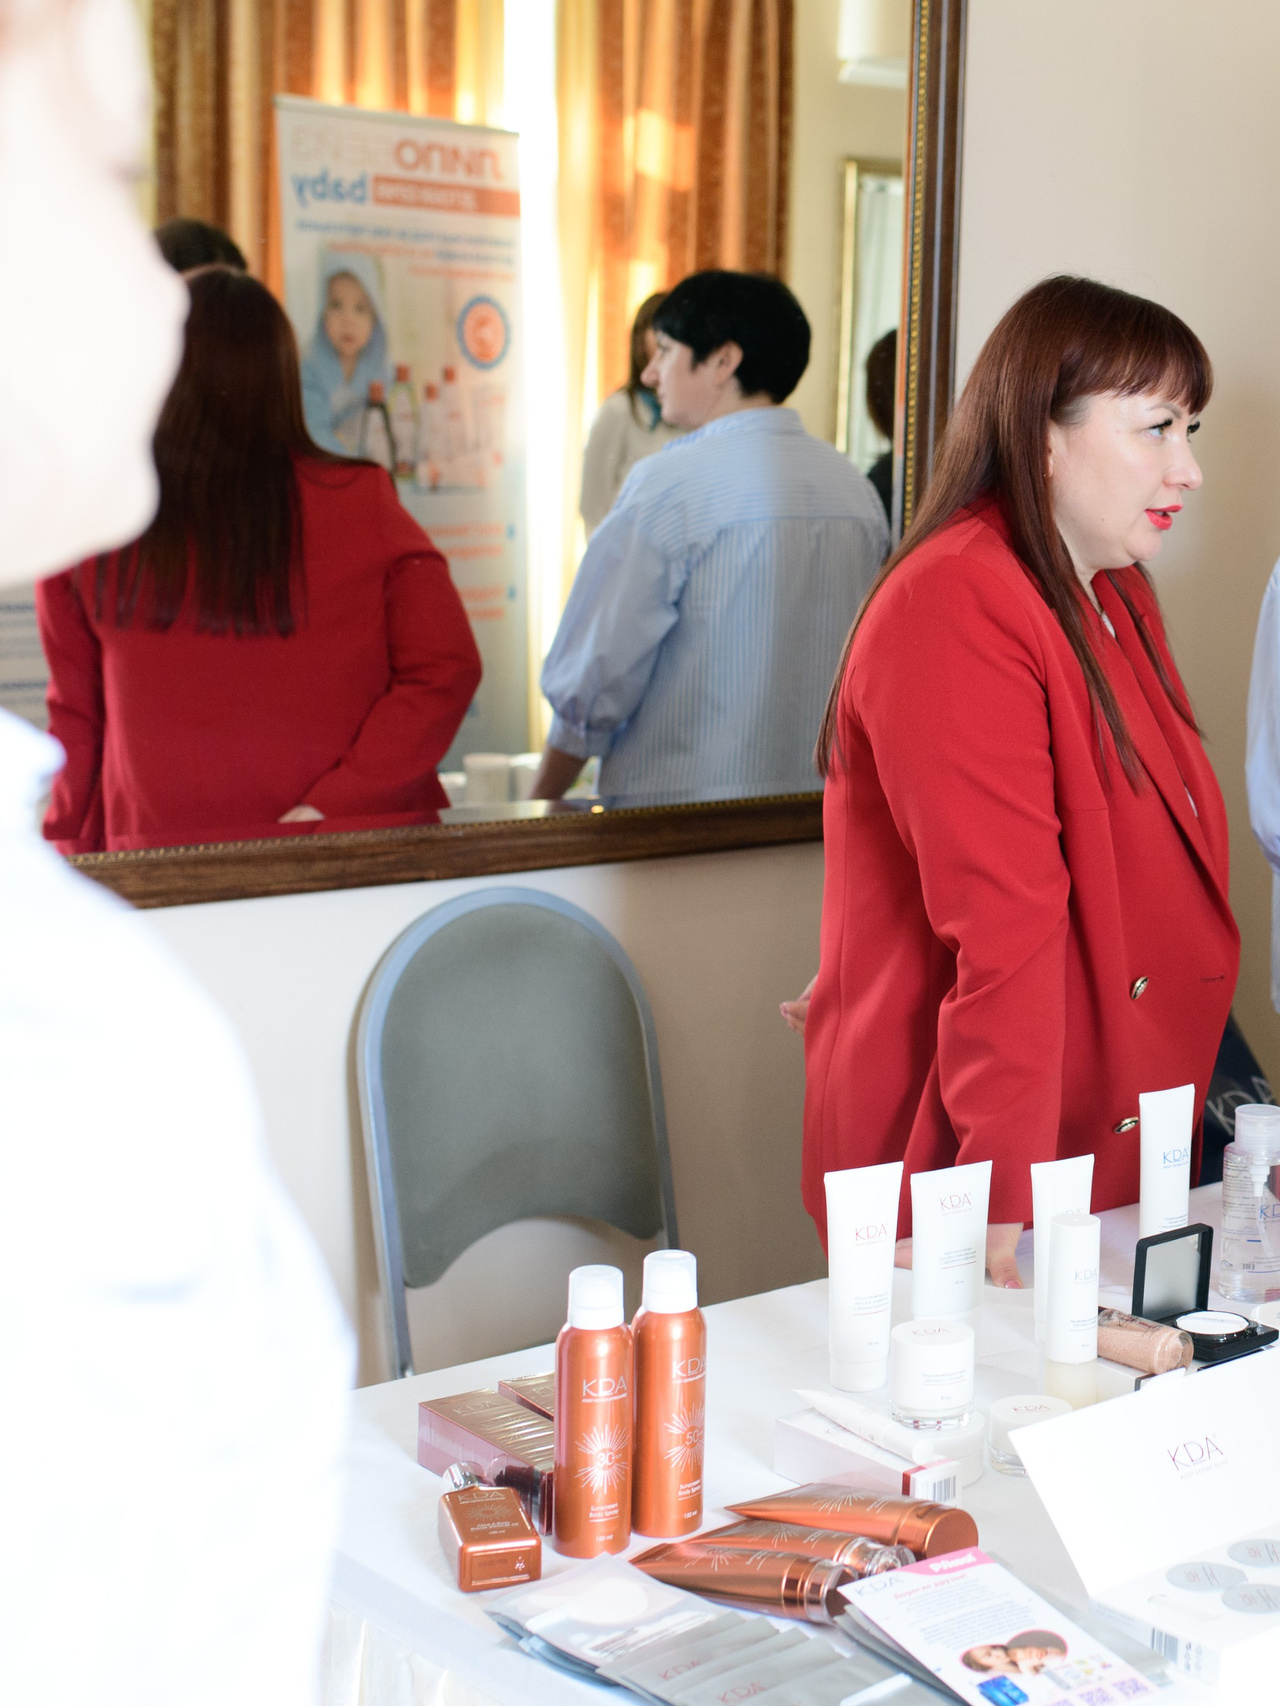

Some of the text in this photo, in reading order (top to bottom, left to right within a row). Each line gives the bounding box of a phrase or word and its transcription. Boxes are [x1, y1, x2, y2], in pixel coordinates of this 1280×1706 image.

[1163, 1148, 1189, 1164] KDA
[940, 1193, 972, 1211] KDA
[855, 1224, 888, 1242] KDA
[582, 1376, 628, 1398] KDA
[597, 1451, 615, 1467] 30
[1166, 1436, 1224, 1471] KDA
[590, 1503, 619, 1512] Sunscreen
[604, 1509, 619, 1517] Spray
